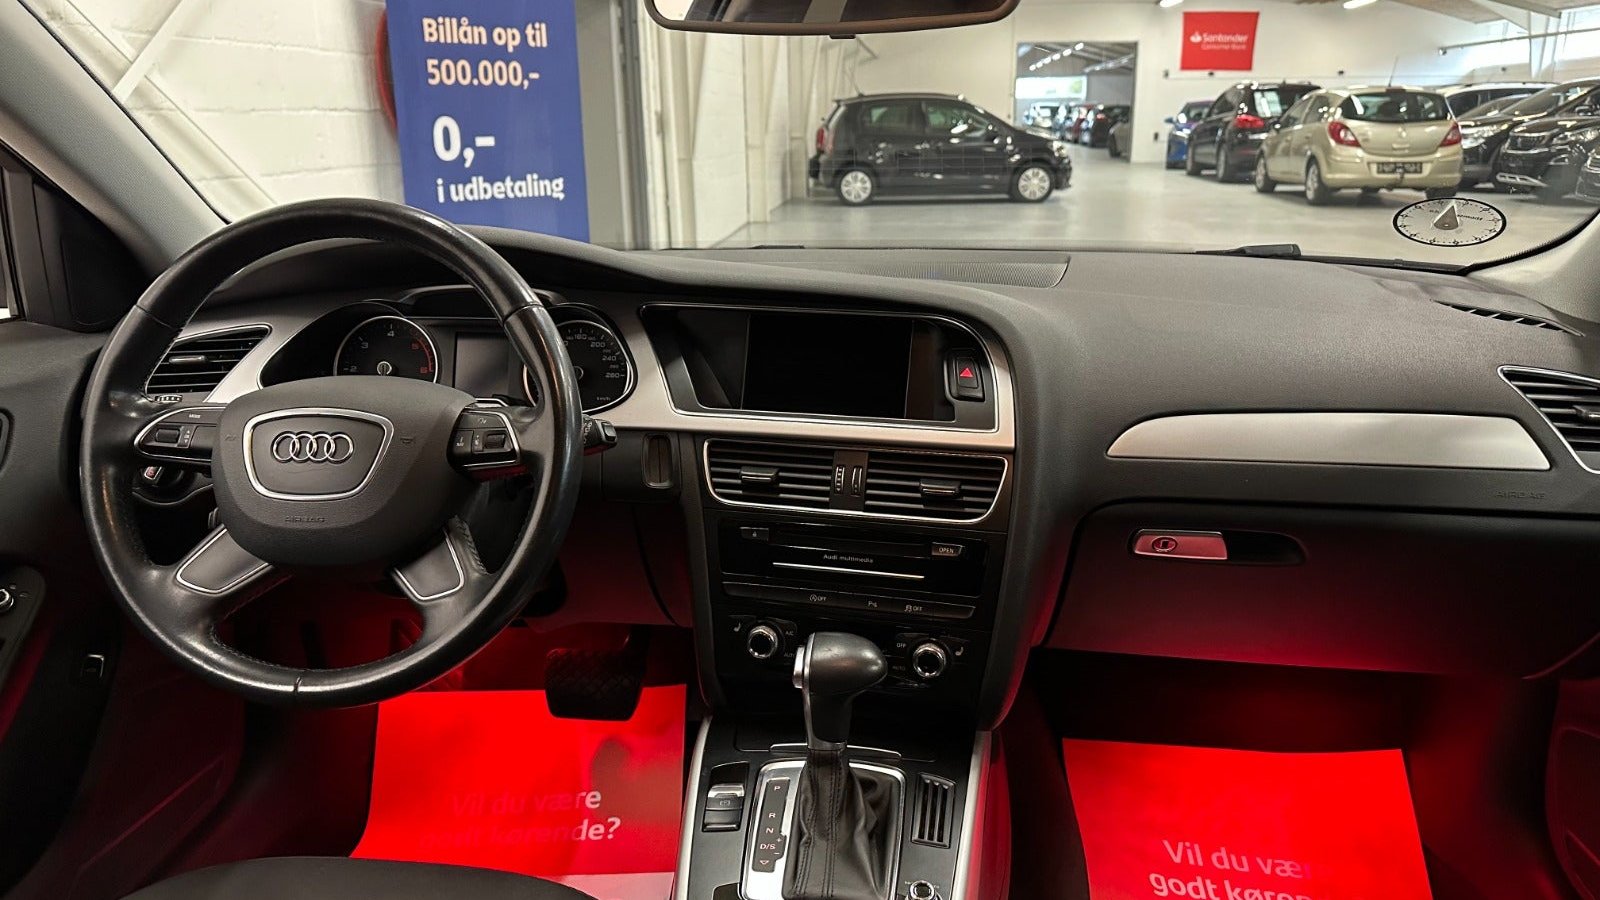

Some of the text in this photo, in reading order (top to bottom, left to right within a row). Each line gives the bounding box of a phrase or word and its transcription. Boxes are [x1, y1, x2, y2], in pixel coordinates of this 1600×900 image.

[422, 16, 548, 52] Billån op til
[1202, 33, 1248, 43] Santander
[426, 59, 540, 89] 500.000,-
[433, 115, 496, 168] 0,-
[436, 173, 566, 203] i udbetaling
[938, 546, 955, 554] OPEN
[1161, 839, 1204, 867] Vil
[1211, 847, 1250, 872] du
[1148, 872, 1221, 900] godt
